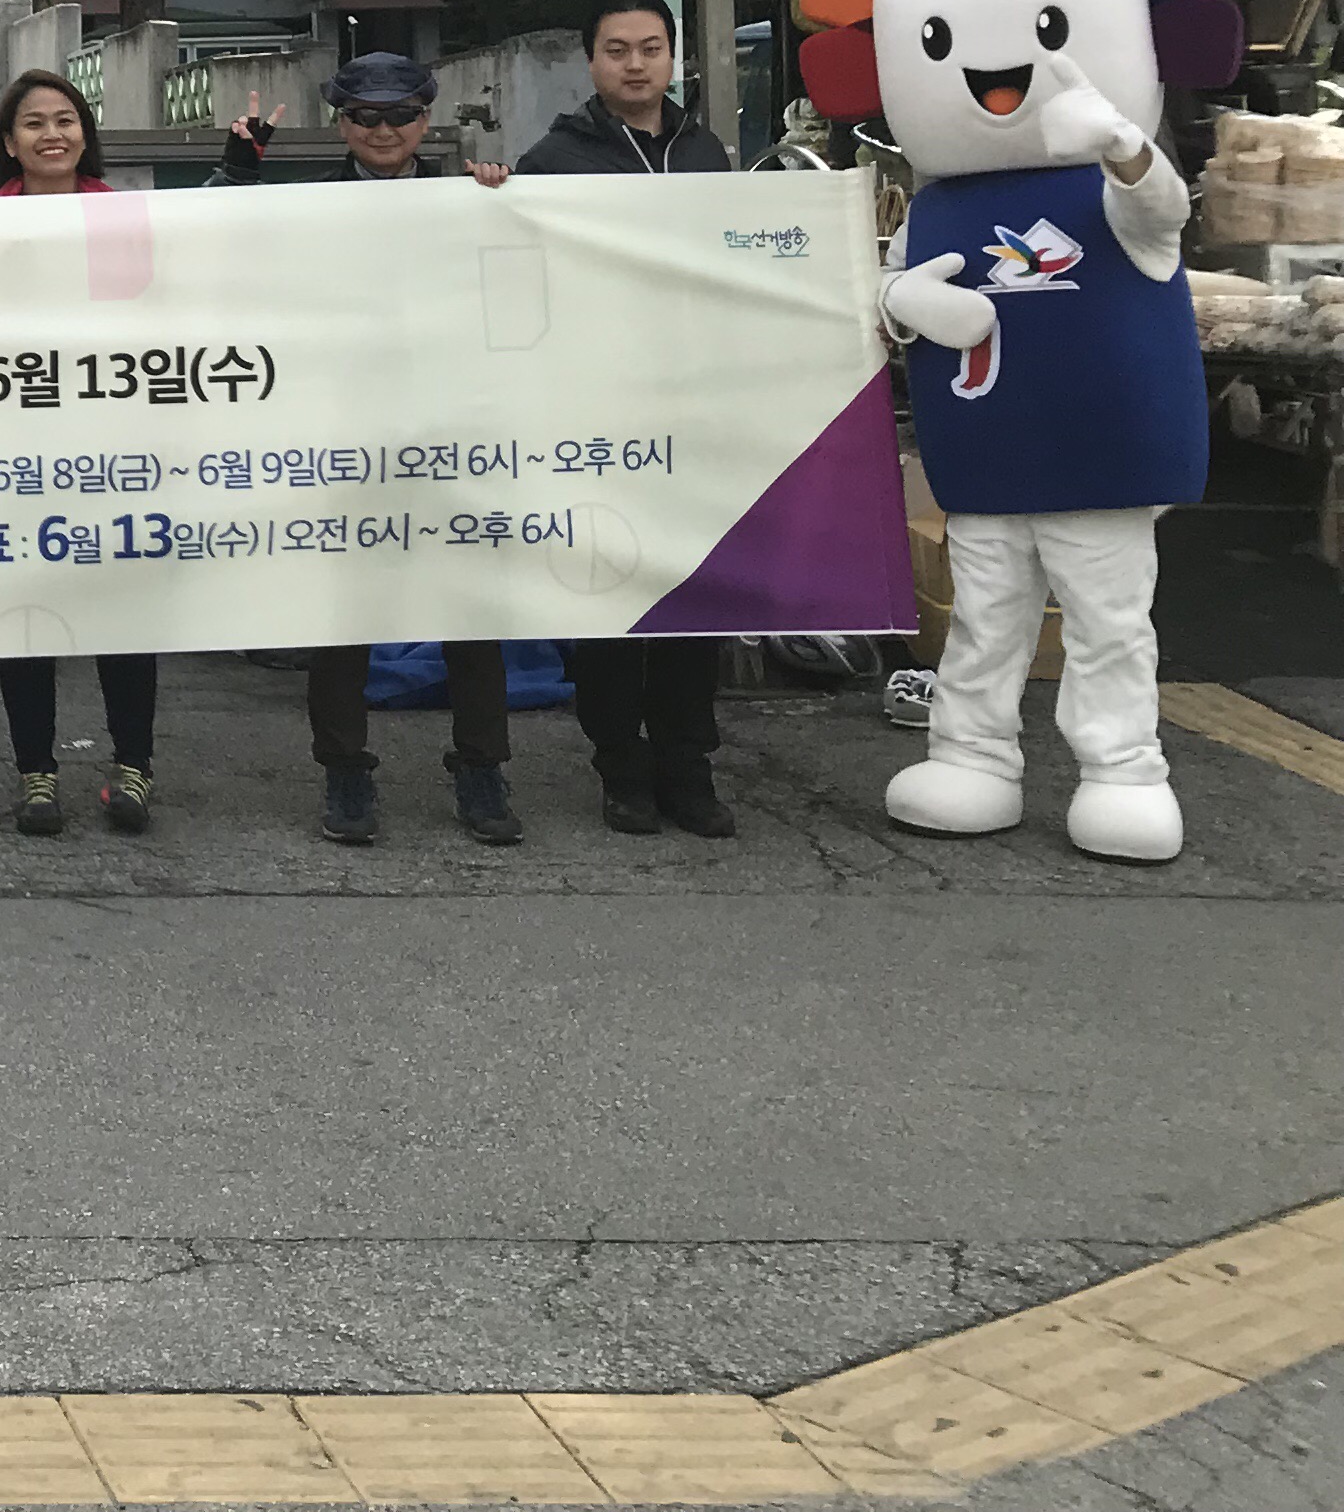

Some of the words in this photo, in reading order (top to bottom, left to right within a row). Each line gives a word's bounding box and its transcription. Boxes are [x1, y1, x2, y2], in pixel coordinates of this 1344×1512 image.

[77, 346, 275, 404] 13일(수)
[53, 454, 161, 493] 8일(금)
[199, 450, 252, 489] 6월
[262, 447, 371, 487] 9일(토)
[394, 443, 458, 480] 오전
[468, 440, 517, 478] 6시
[553, 438, 615, 476] 오후
[623, 435, 671, 474] 6시
[38, 516, 101, 564] 6월
[113, 513, 258, 560] 13일(수)
[282, 515, 347, 552] 오전
[358, 513, 409, 550] 6시
[446, 512, 513, 548] 오후
[522, 509, 572, 547] 6시
